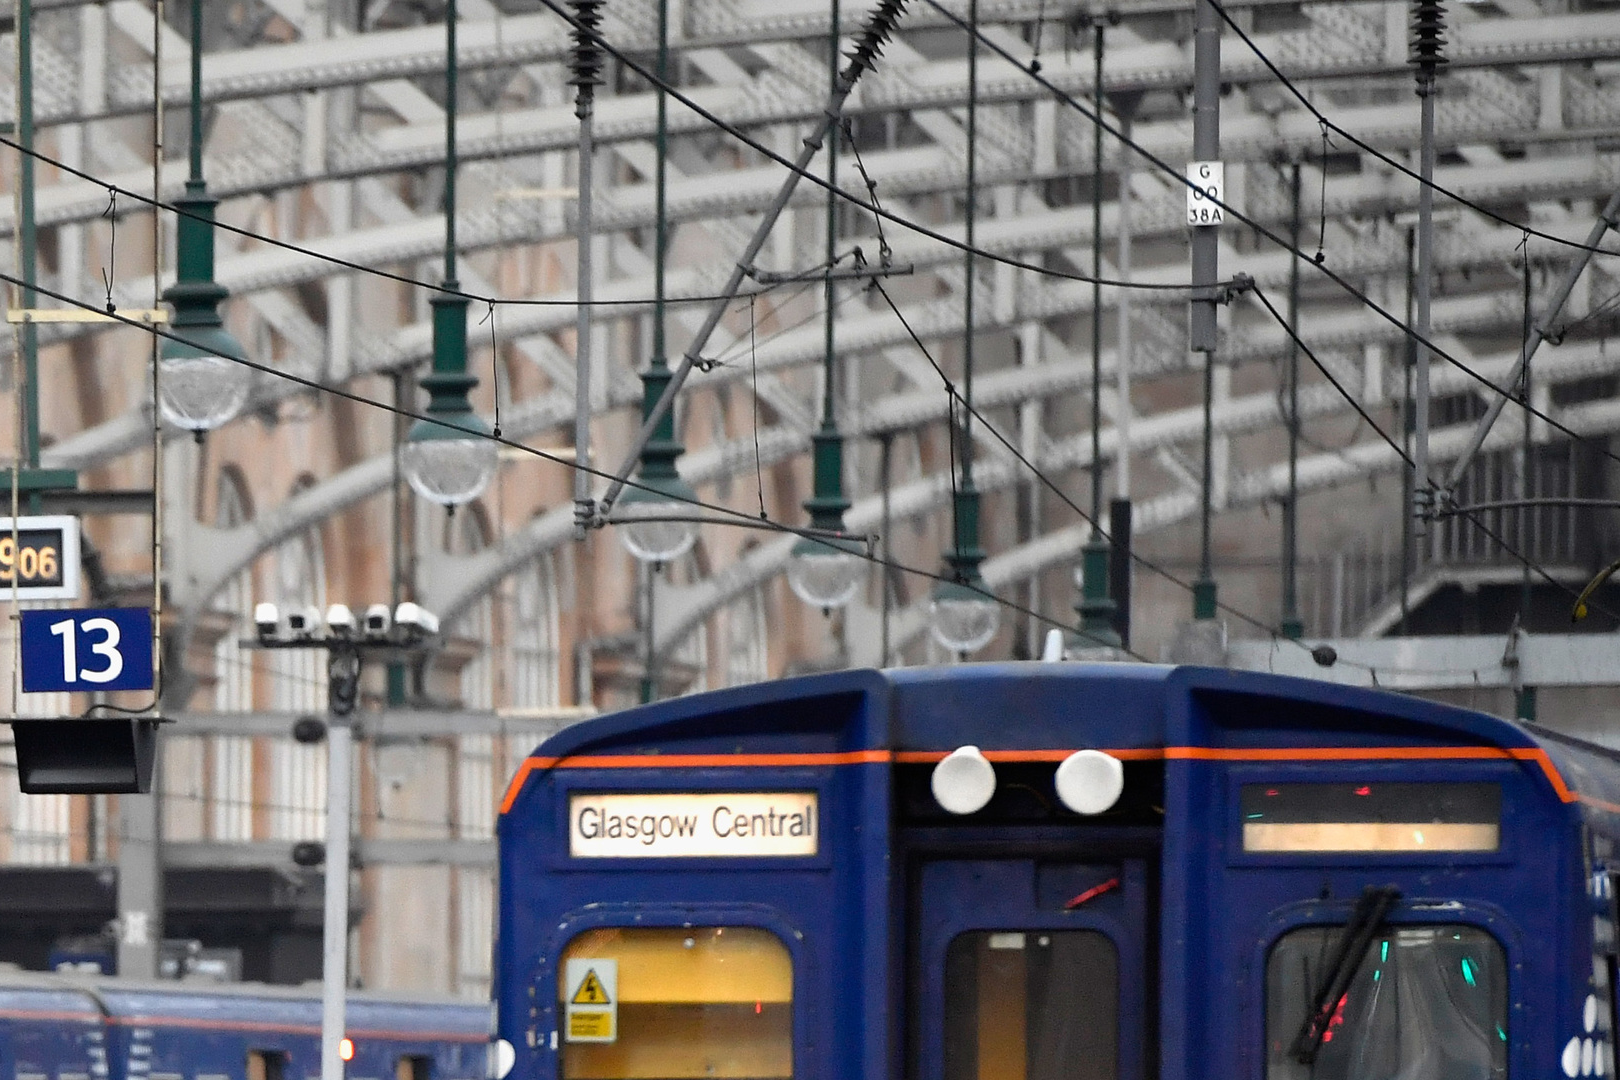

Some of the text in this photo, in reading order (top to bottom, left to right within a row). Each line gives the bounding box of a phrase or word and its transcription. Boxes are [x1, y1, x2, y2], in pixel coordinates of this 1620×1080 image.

[1200, 164, 1211, 179] G
[1189, 208, 1222, 223] 38A
[50, 617, 123, 683] 13
[580, 805, 812, 845] Glasgow Central
